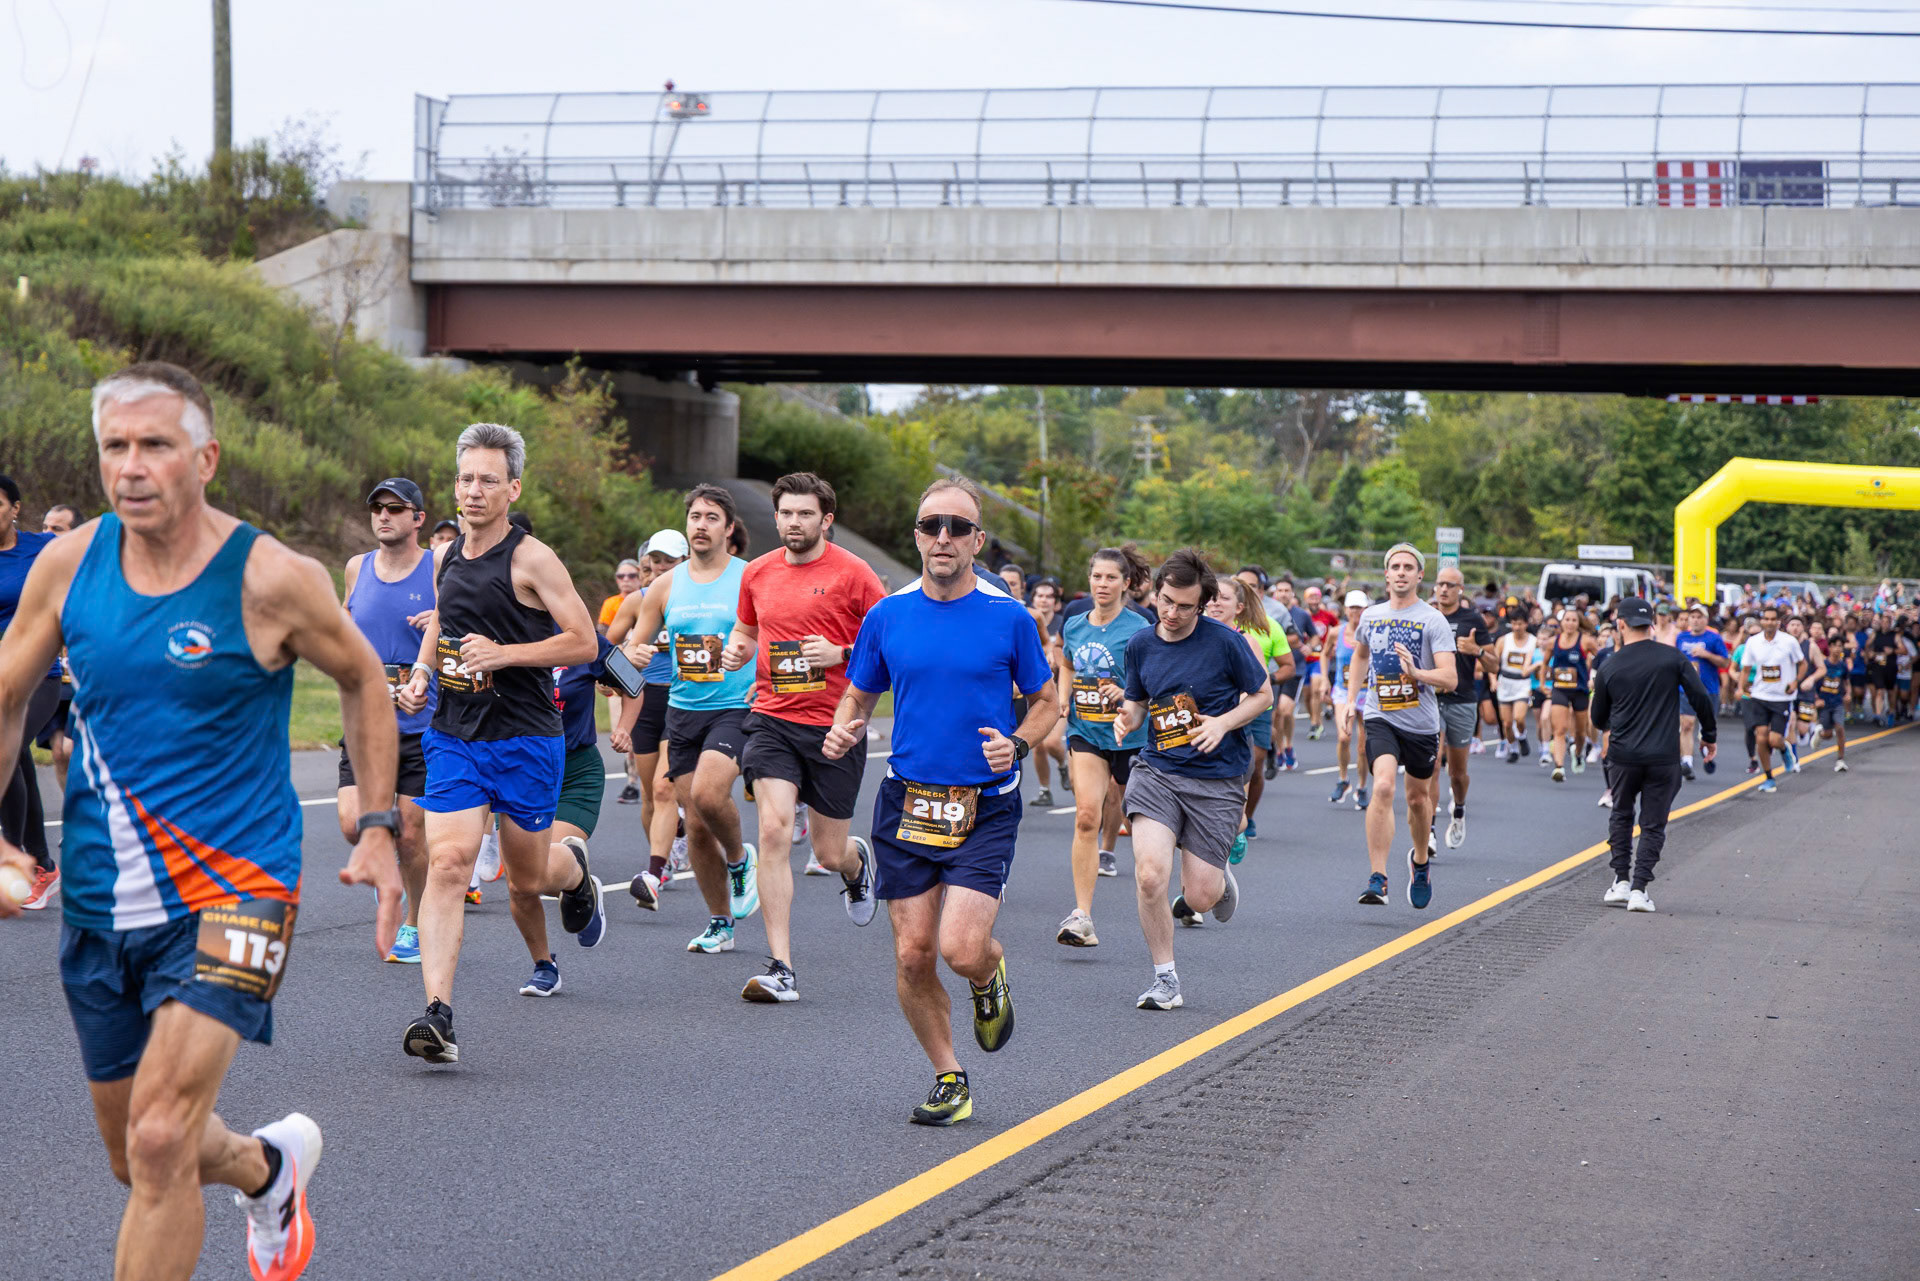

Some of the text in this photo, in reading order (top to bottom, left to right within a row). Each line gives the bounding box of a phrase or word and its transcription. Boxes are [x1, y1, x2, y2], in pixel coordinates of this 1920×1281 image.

[437, 647, 459, 656] CHASE
[682, 649, 711, 664] 30
[1087, 641, 1116, 667] TOGETHER
[442, 657, 483, 681] 24
[777, 657, 811, 673] 48
[1378, 684, 1414, 696] 275
[1156, 709, 1193, 730] 143
[907, 786, 946, 799] CHASE 5K
[912, 797, 965, 822] 219
[202, 911, 260, 929] CHASE
[224, 927, 287, 975] 113
